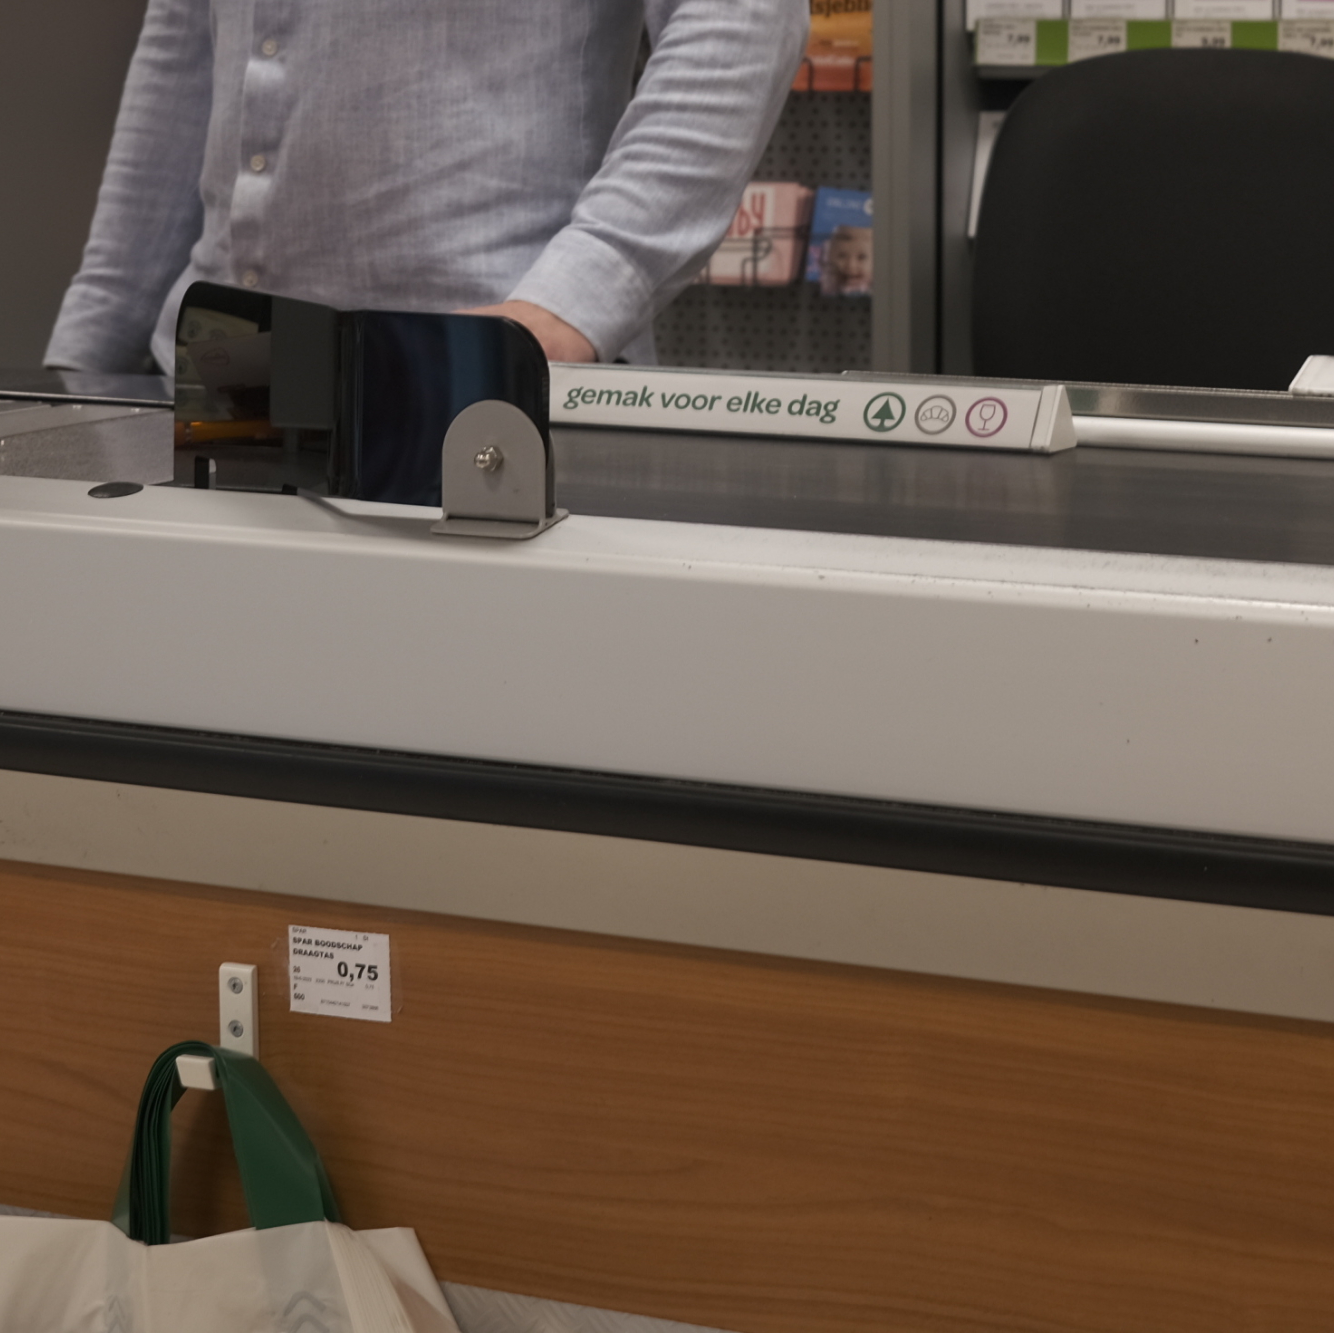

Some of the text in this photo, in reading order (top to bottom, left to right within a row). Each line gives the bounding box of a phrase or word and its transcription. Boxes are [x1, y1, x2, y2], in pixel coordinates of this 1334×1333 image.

[563, 384, 841, 425] gemak voor elke dag
[292, 936, 363, 951] SPAR BOODSCHAP
[292, 947, 334, 959] DRAAGTAS
[337, 961, 379, 982] 0,75
